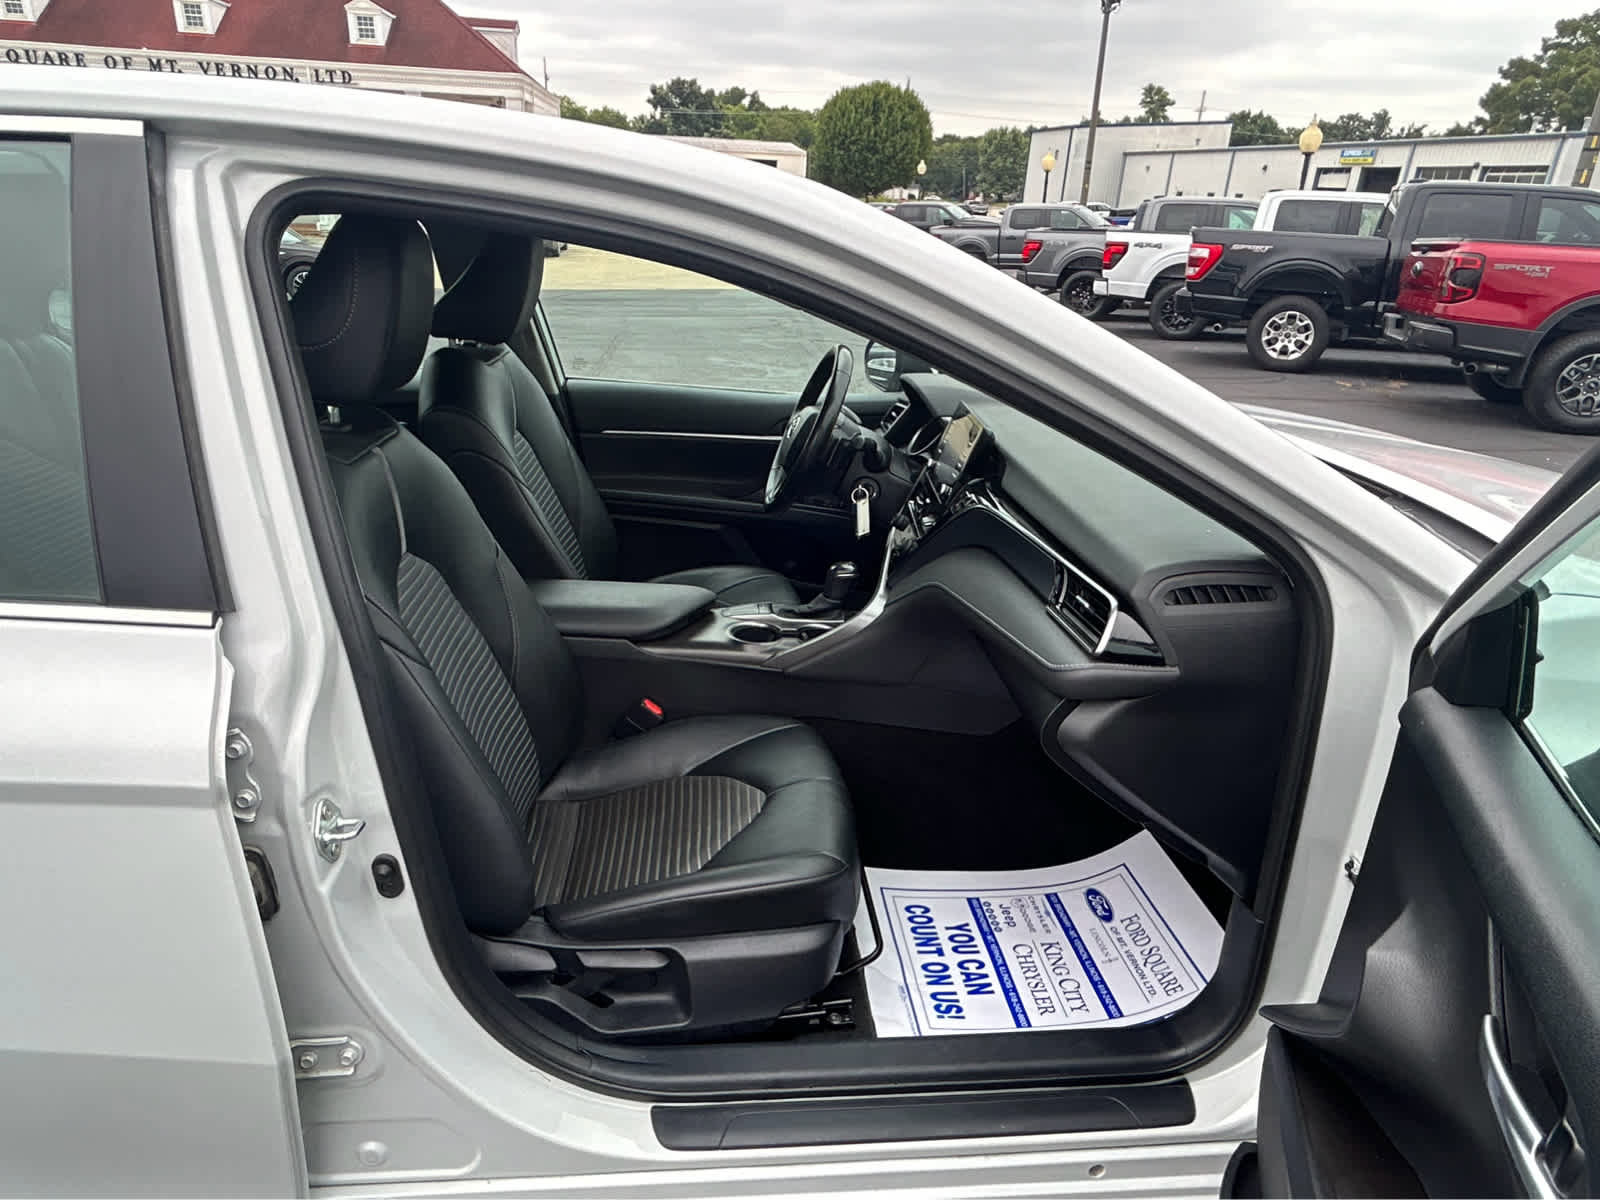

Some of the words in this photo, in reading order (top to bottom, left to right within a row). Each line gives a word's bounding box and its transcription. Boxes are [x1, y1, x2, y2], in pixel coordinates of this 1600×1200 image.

[6, 49, 87, 67] QUARE
[104, 55, 133, 70] OF
[148, 57, 184, 73] MT.
[1494, 263, 1555, 273] SPORT
[999, 903, 1017, 928] Jeep
[1028, 896, 1051, 934] CHRYSLER
[1087, 892, 1112, 920] Ford
[904, 904, 945, 957] COUNT
[944, 922, 980, 955] YOU
[1119, 913, 1152, 948] FORD
[1140, 945, 1185, 997] SQUARE
[1124, 947, 1149, 981] VERNON
[921, 962, 955, 986] ON
[957, 959, 995, 995] CAN
[1012, 943, 1056, 1016] CHRYSLER
[1040, 940, 1070, 977] KING
[1059, 978, 1090, 1013] CITY
[929, 991, 966, 1020] US!
